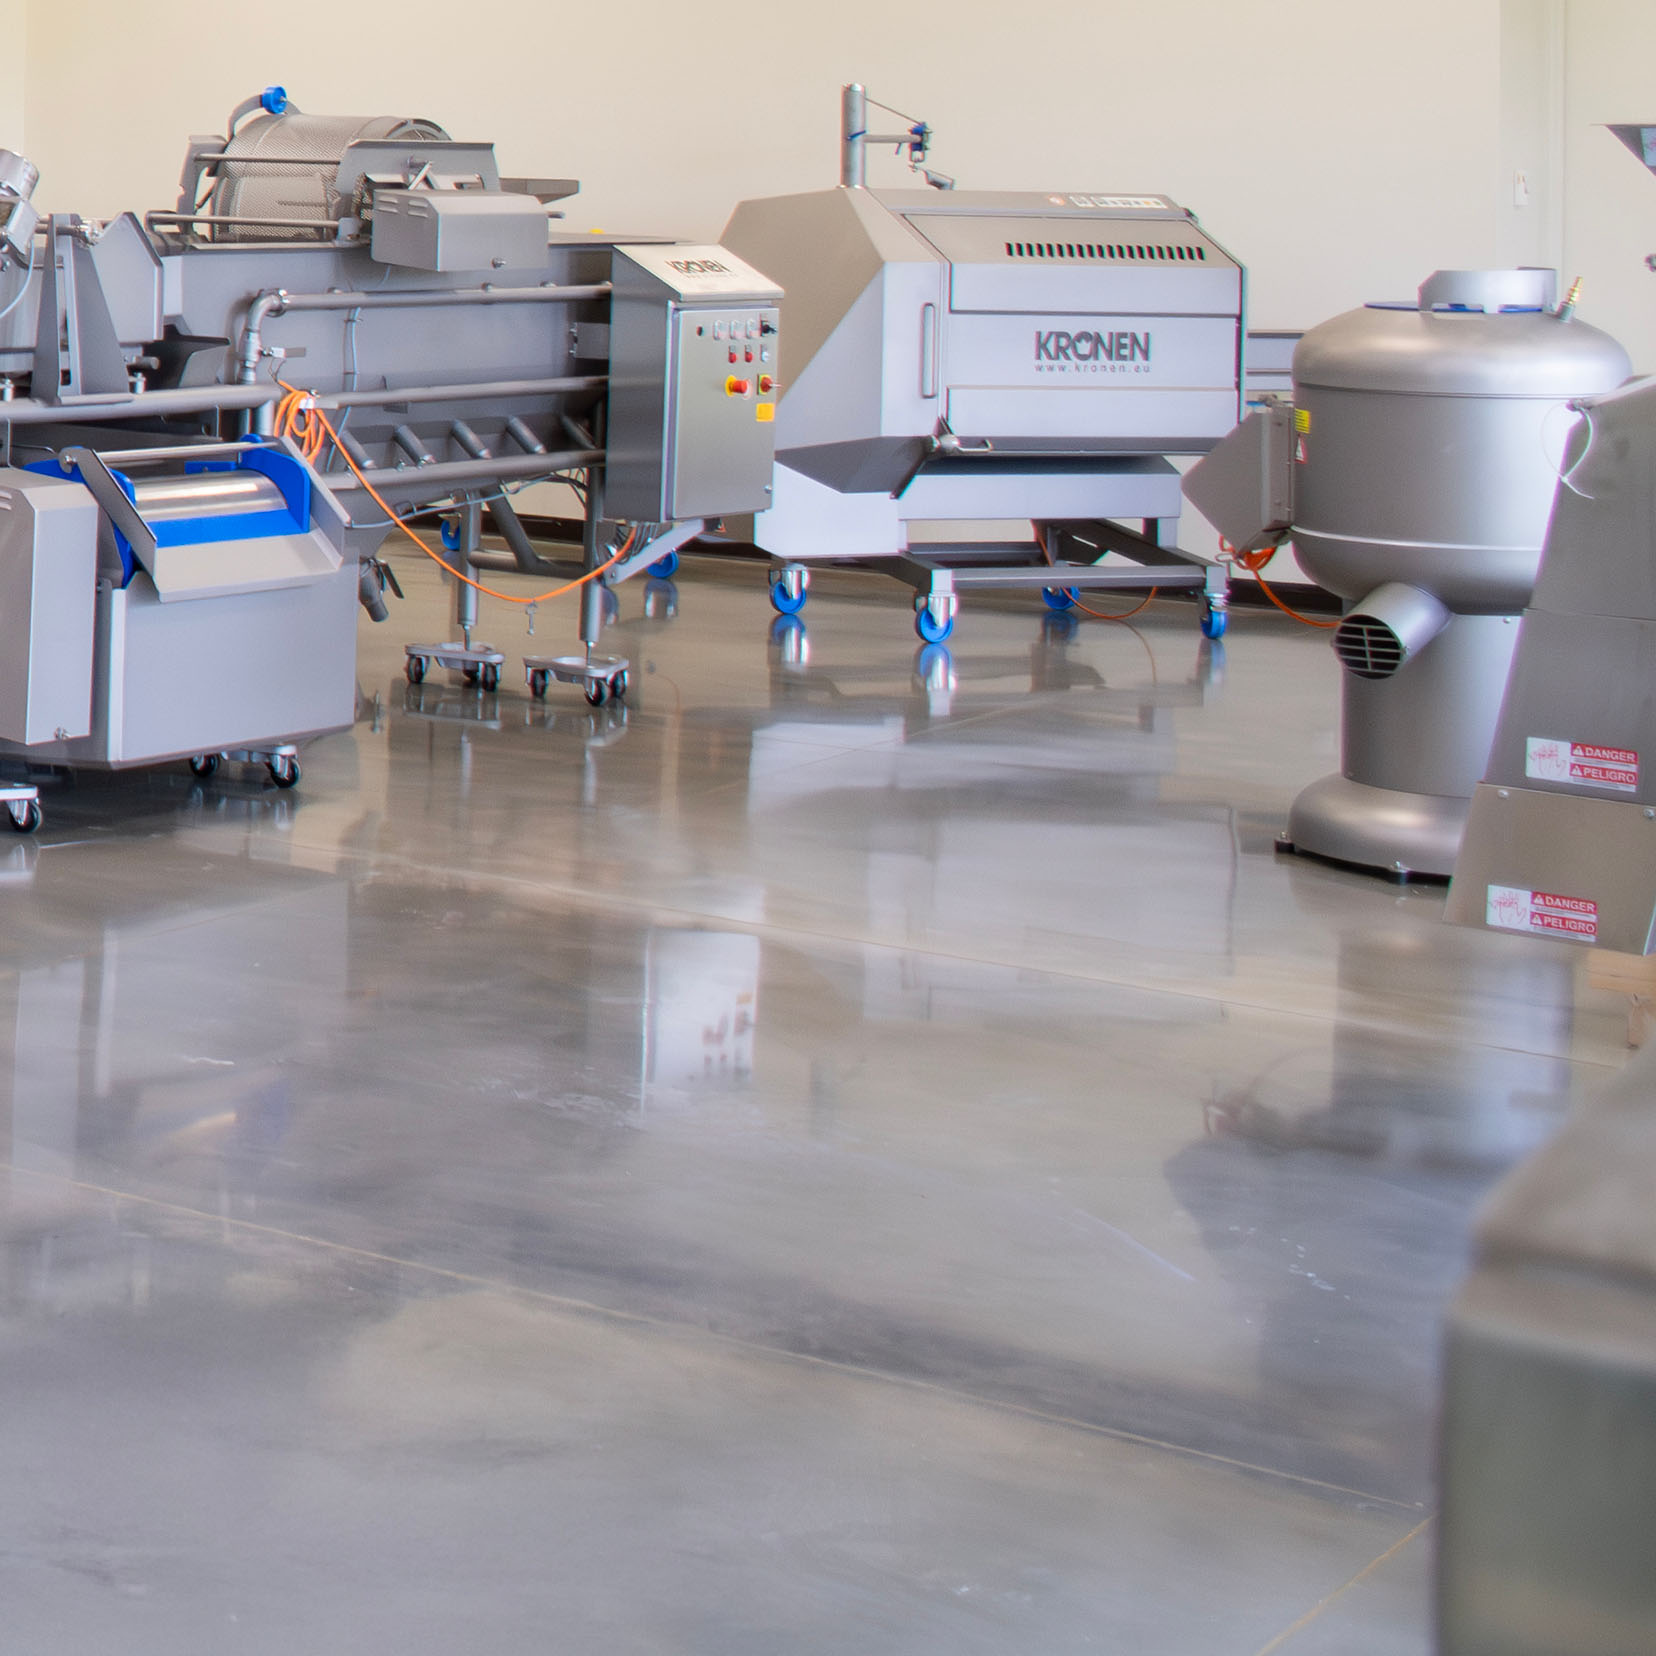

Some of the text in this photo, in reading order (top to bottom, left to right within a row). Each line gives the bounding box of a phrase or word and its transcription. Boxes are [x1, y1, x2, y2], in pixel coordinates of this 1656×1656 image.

[1034, 331, 1150, 361] KRONEN
[1034, 363, 1151, 373] www.kronen.eu
[1585, 747, 1636, 762] DANGER
[1583, 768, 1636, 783] PELIGRO
[1545, 896, 1595, 912] DANGER
[1543, 916, 1596, 933] PELIGRO
